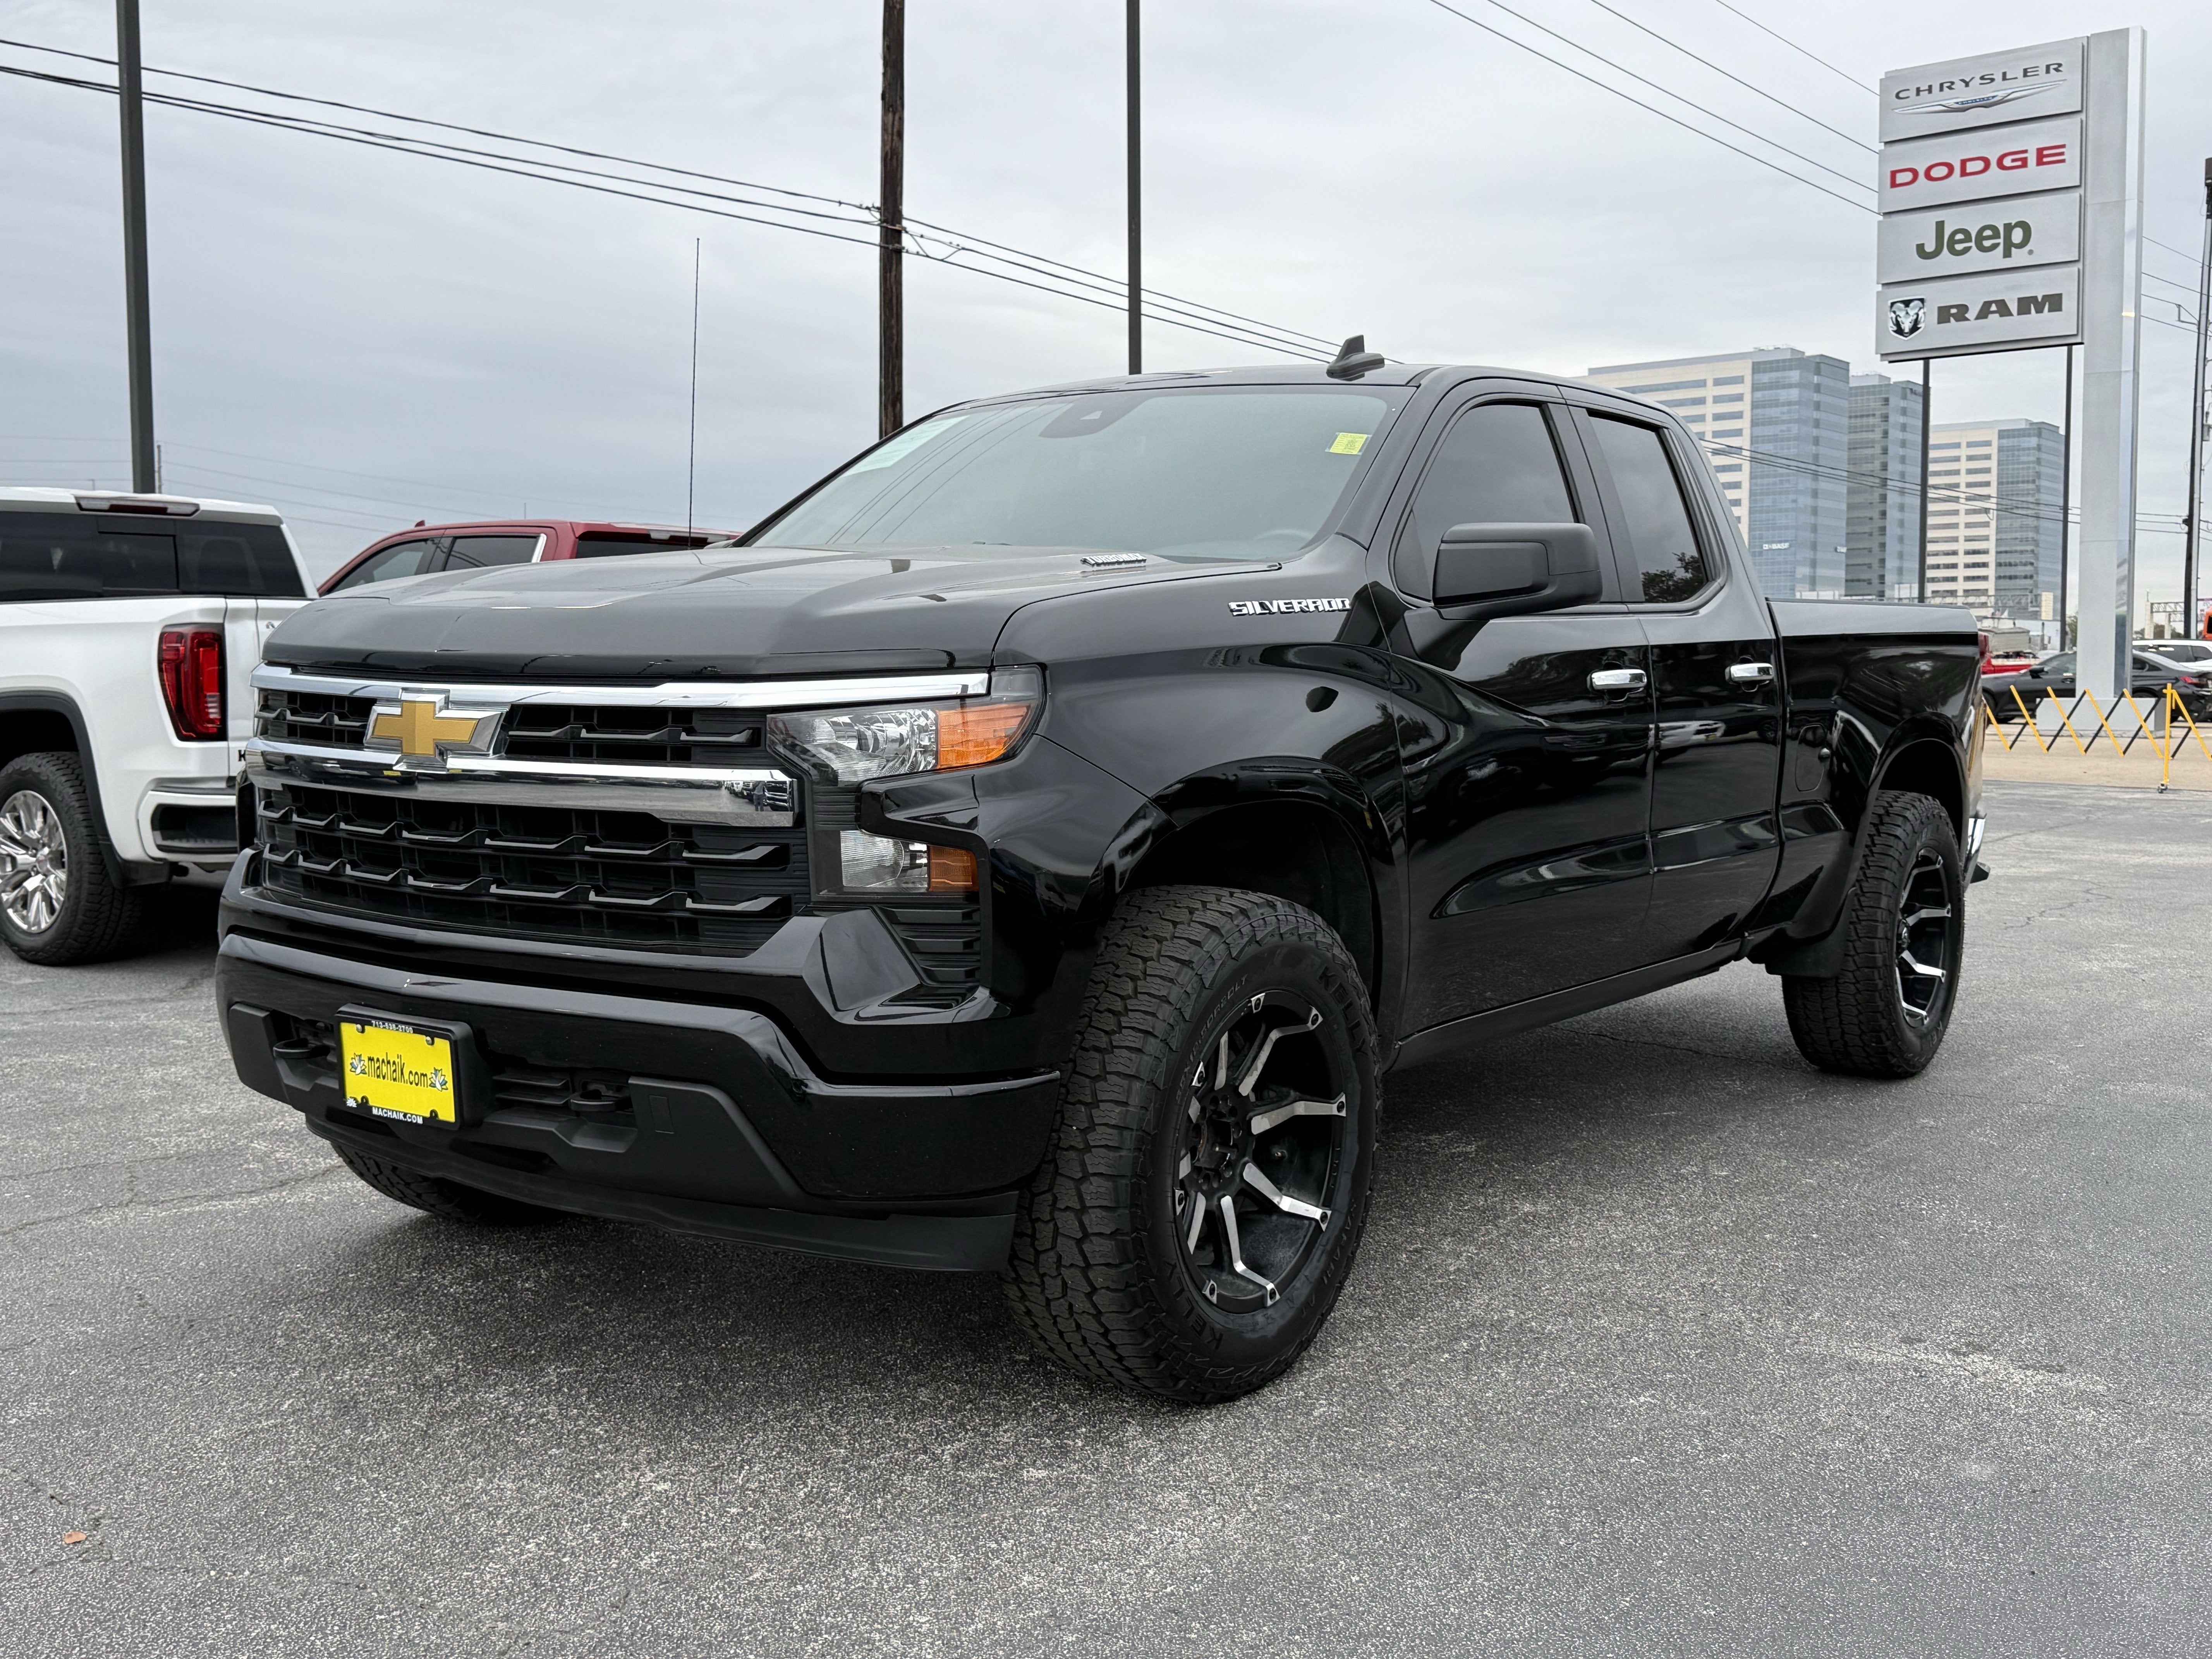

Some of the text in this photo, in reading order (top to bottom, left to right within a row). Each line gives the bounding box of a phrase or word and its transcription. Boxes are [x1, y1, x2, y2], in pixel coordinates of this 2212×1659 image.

[1895, 62, 2064, 100] CHRYSLER
[1890, 144, 2066, 188] DODGE
[1916, 219, 2032, 259] Jeep
[1937, 293, 2063, 325] RAM
[1083, 553, 1147, 565] TURBOMAX
[1228, 598, 1351, 616] SILVERADO
[1317, 965, 1369, 1056] KELLY
[367, 1052, 428, 1088] machaik.com
[372, 1106, 422, 1123] MACHAIK.COM
[1165, 1261, 1223, 1350] KELLY
